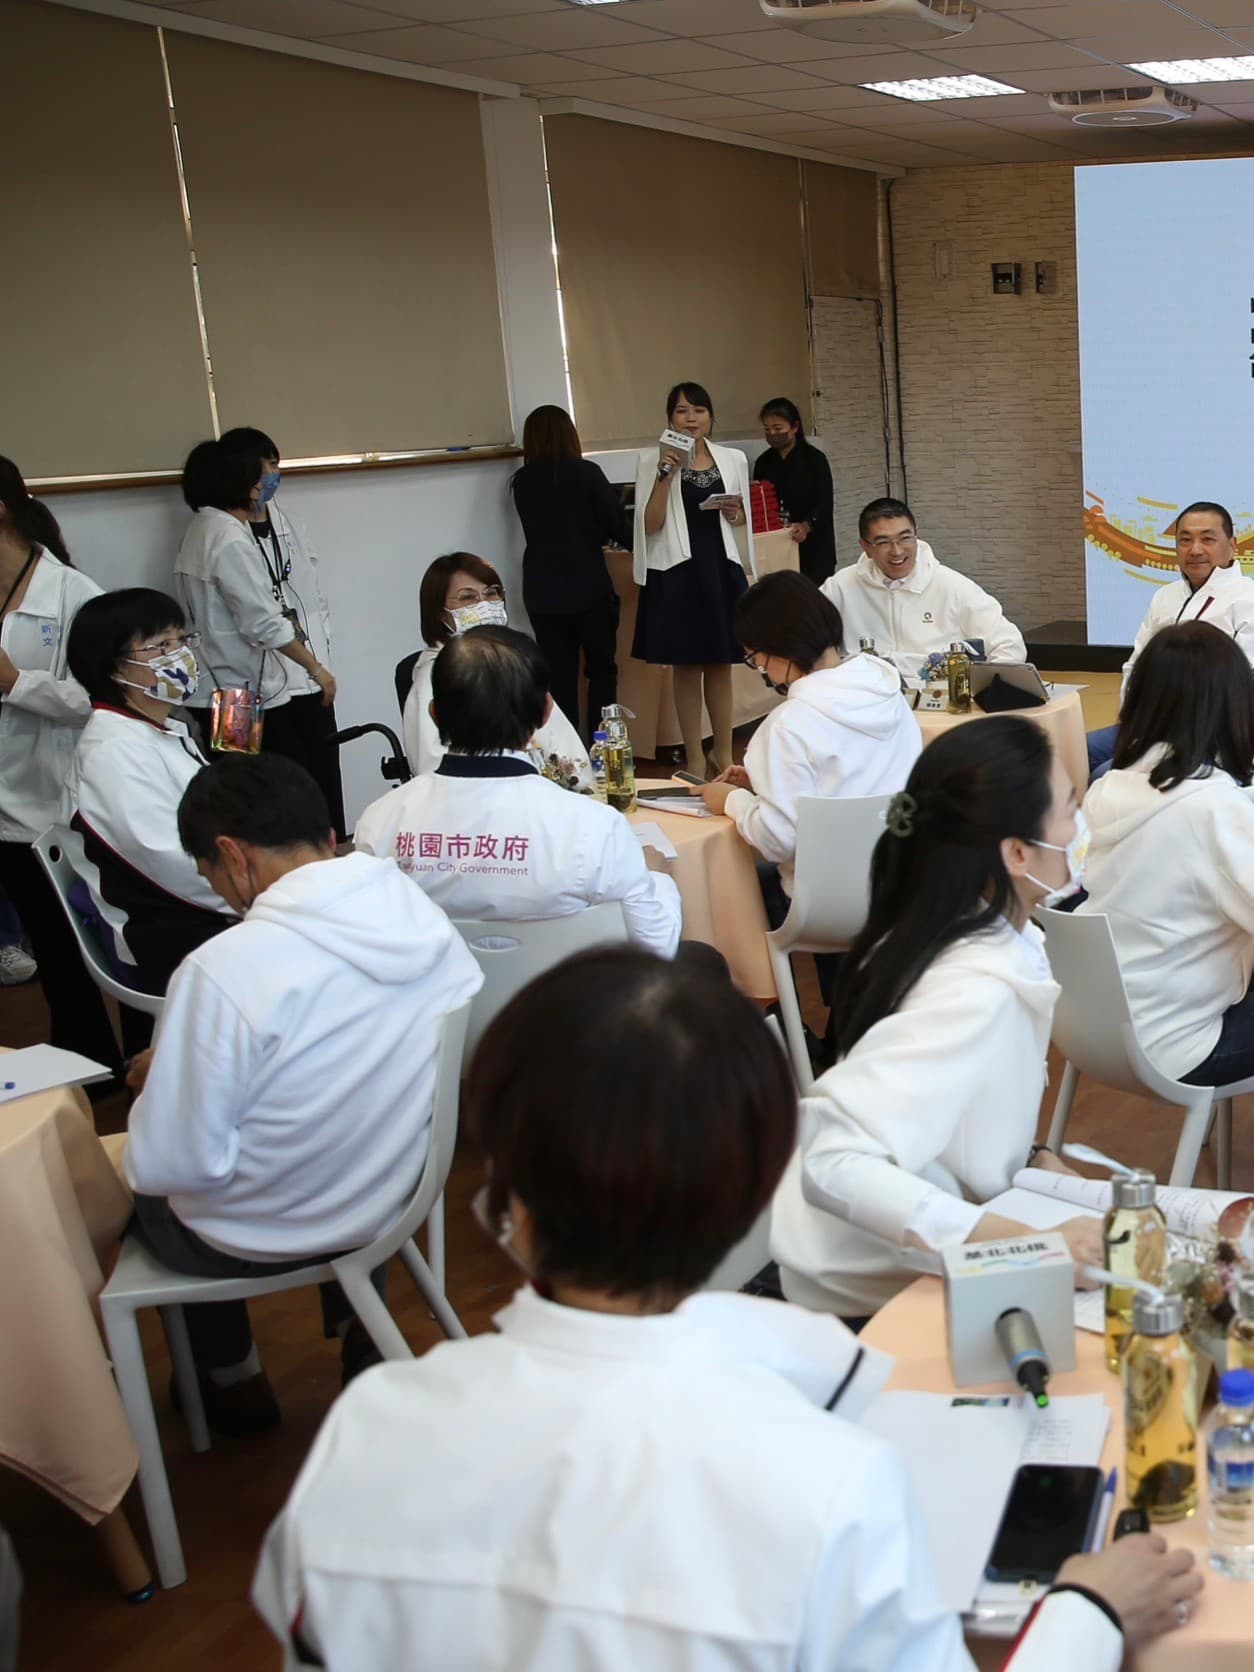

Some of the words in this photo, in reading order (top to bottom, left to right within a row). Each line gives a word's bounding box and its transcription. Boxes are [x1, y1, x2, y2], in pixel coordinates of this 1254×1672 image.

[395, 832, 529, 861] 桃園市政府
[460, 862, 528, 876] Government
